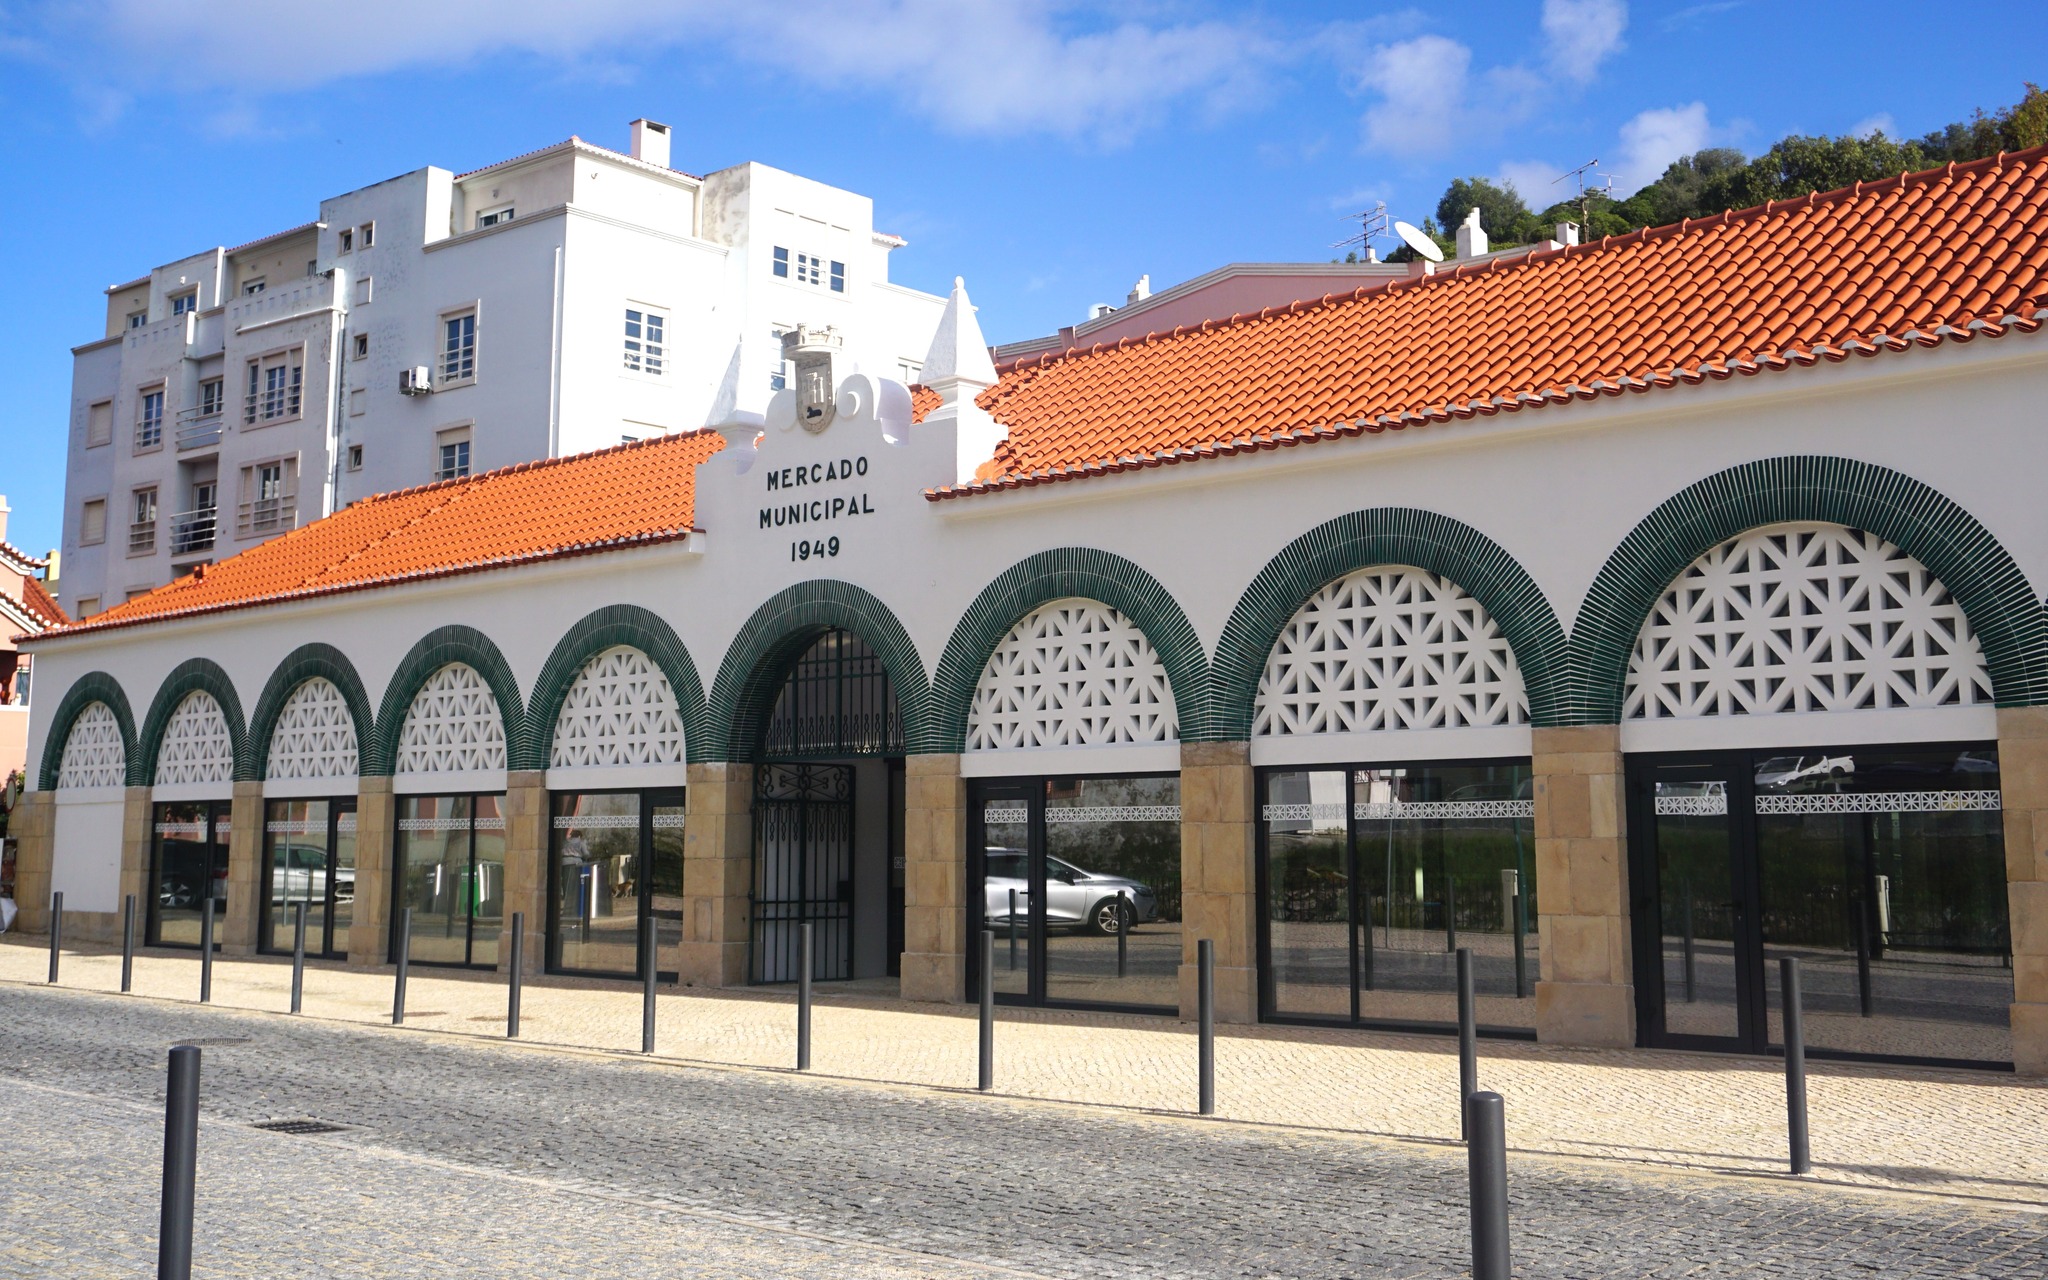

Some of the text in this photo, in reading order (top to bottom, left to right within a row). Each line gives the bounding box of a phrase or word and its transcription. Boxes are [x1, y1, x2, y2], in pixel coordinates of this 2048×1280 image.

[767, 456, 868, 491] MERCADO
[760, 493, 875, 529] MUNICIPAL
[791, 536, 840, 562] 1949
